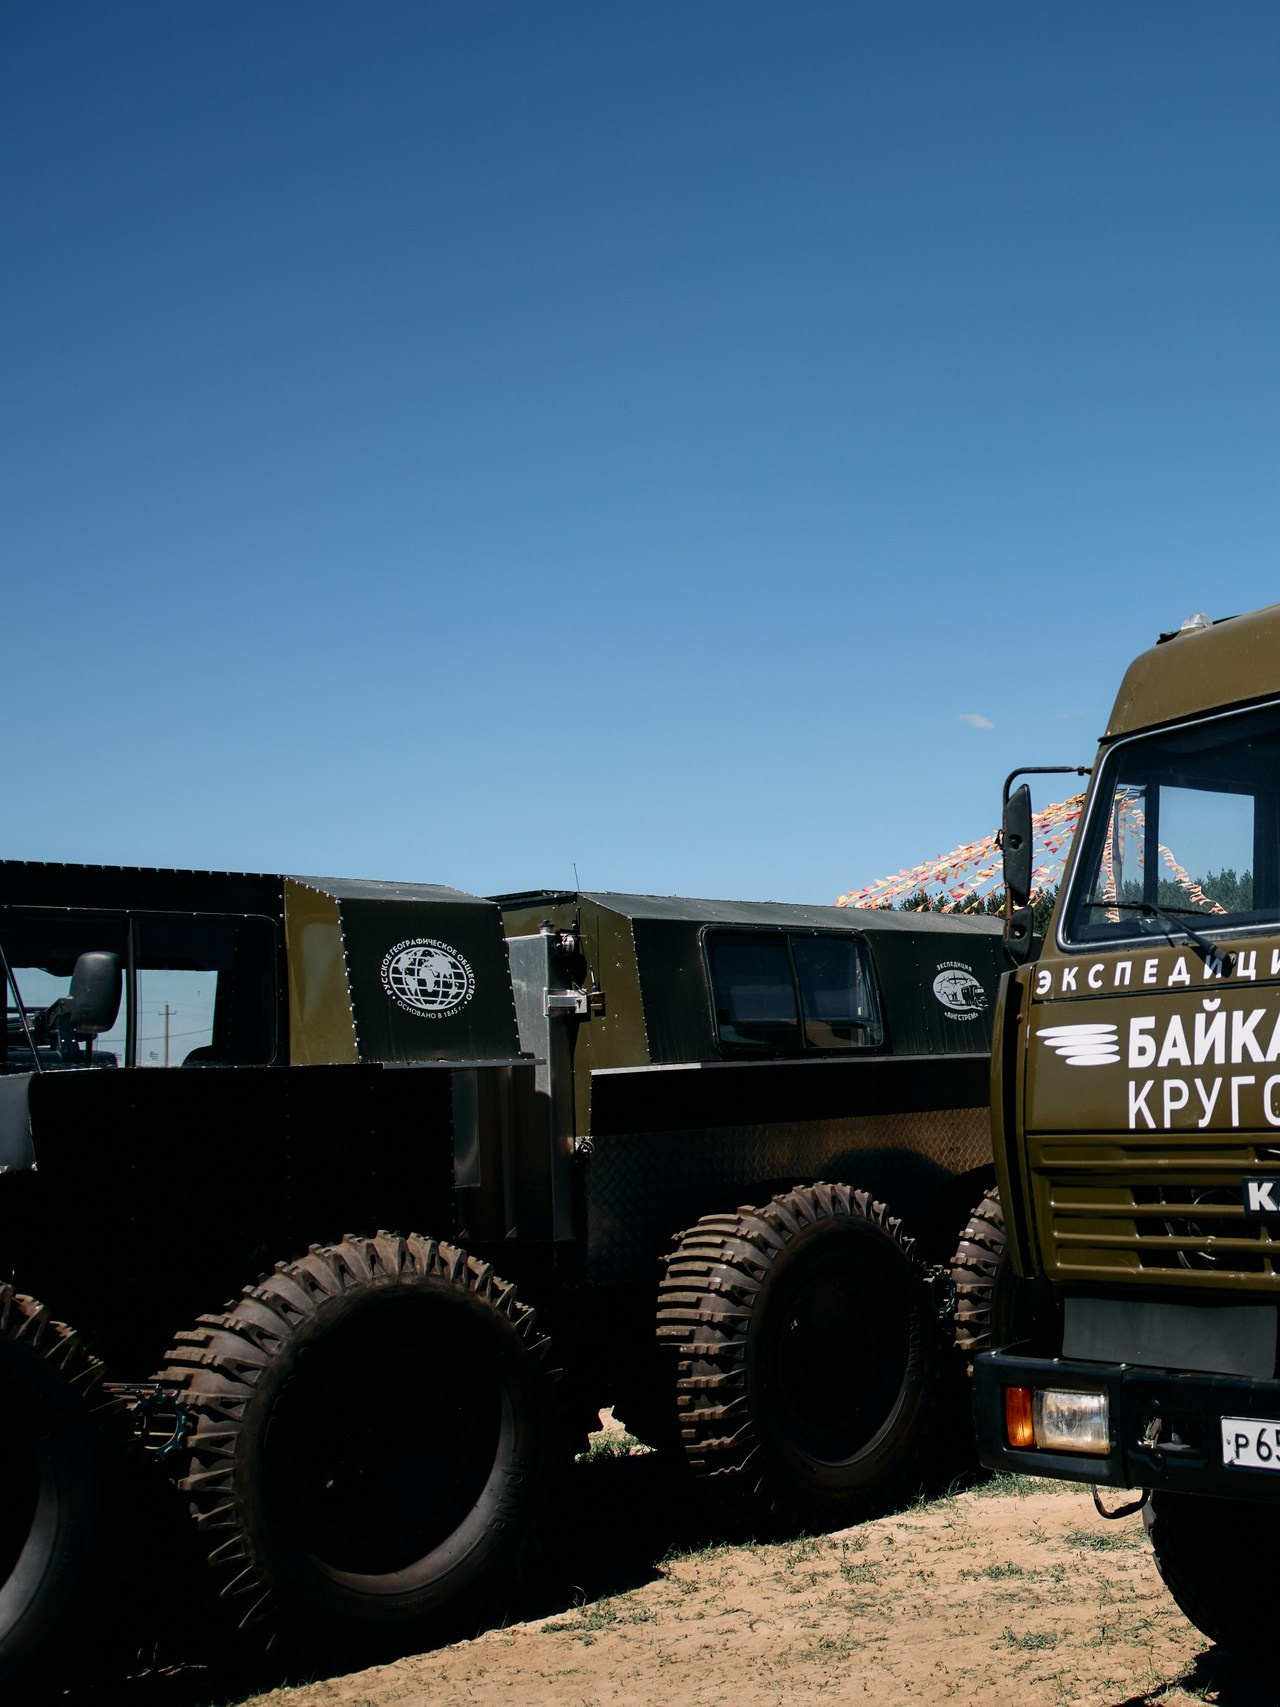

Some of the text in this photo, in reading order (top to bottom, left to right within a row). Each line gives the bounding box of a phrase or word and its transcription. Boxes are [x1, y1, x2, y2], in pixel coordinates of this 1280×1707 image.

[380, 938, 476, 1001] РУССКОЕ ГЕОГРАФИЧЕСКОЕ ОБЩЕСТВО
[397, 1001, 436, 1019] ОСНОВАНО
[443, 1008, 458, 1018] 1845
